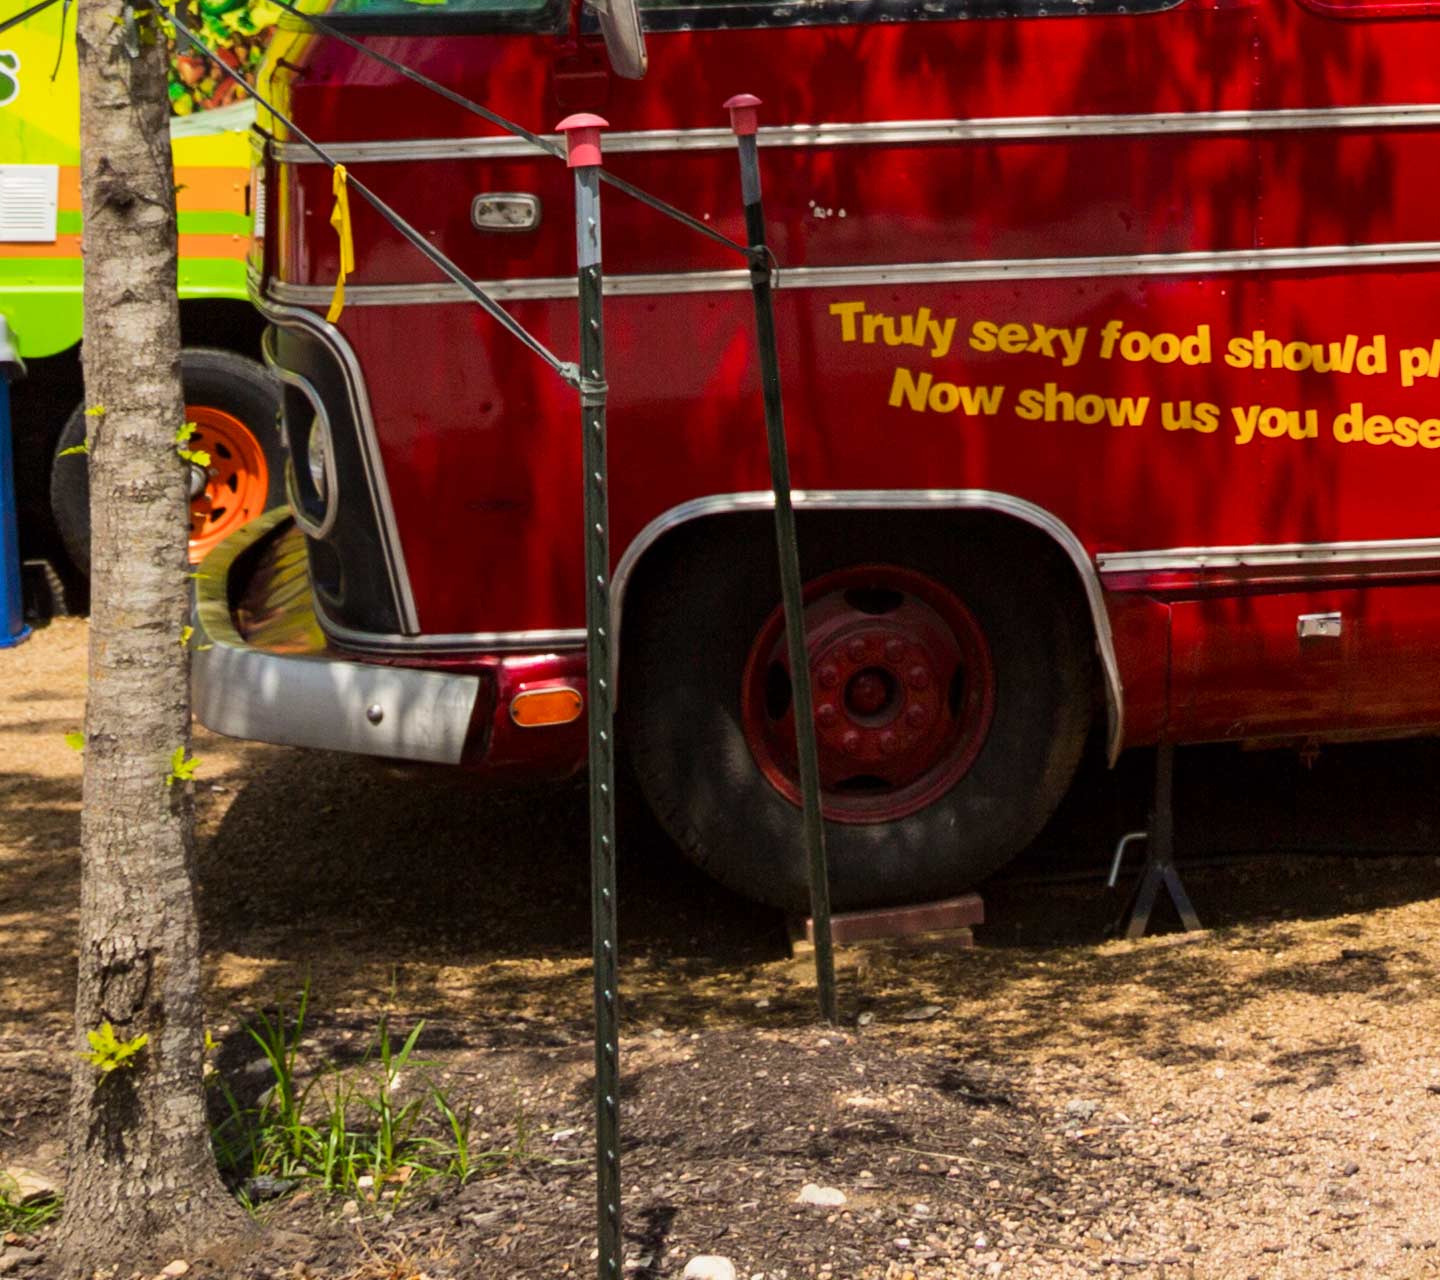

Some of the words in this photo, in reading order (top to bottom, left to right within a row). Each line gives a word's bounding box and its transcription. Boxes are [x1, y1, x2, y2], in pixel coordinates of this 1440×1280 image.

[829, 301, 957, 357] Truly
[968, 318, 1088, 367] sexy
[1099, 320, 1212, 365] food
[1224, 330, 1387, 376] should
[888, 366, 1005, 416] Now
[1014, 382, 1150, 427] show
[1160, 399, 1221, 433] us
[1230, 403, 1318, 445] you
